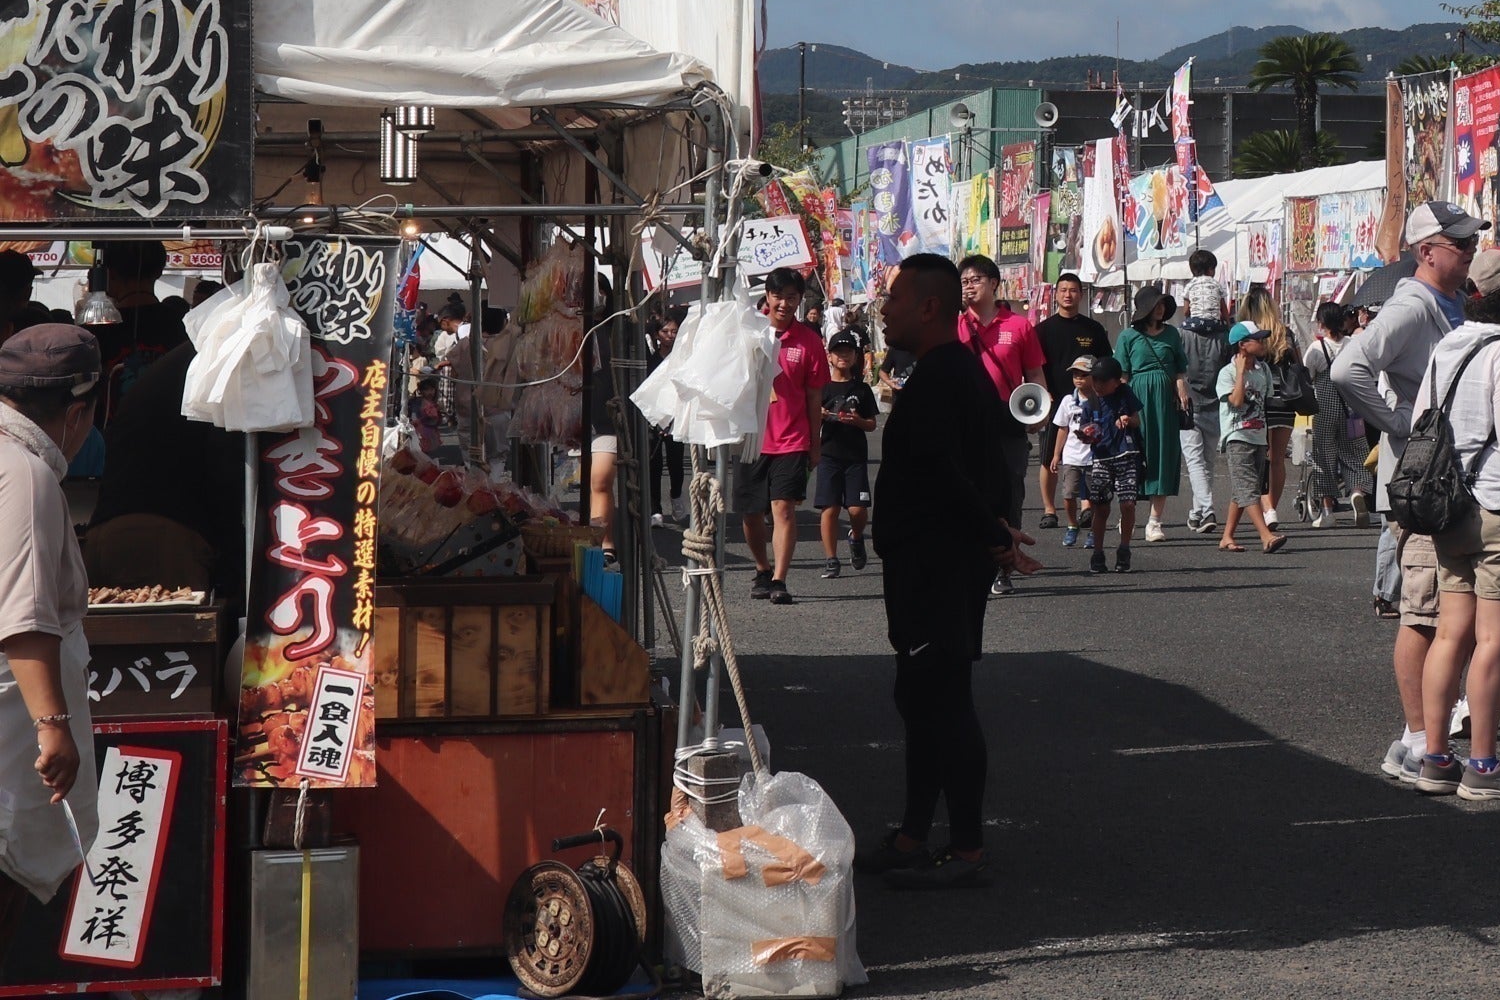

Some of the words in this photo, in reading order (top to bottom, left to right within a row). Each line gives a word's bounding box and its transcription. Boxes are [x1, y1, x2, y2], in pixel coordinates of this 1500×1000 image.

[191, 254, 222, 264] ¥600
[352, 359, 387, 658] 店主自慢の特選素材!
[308, 683, 355, 770] 一食入魂
[80, 760, 159, 950] 博多発祥
